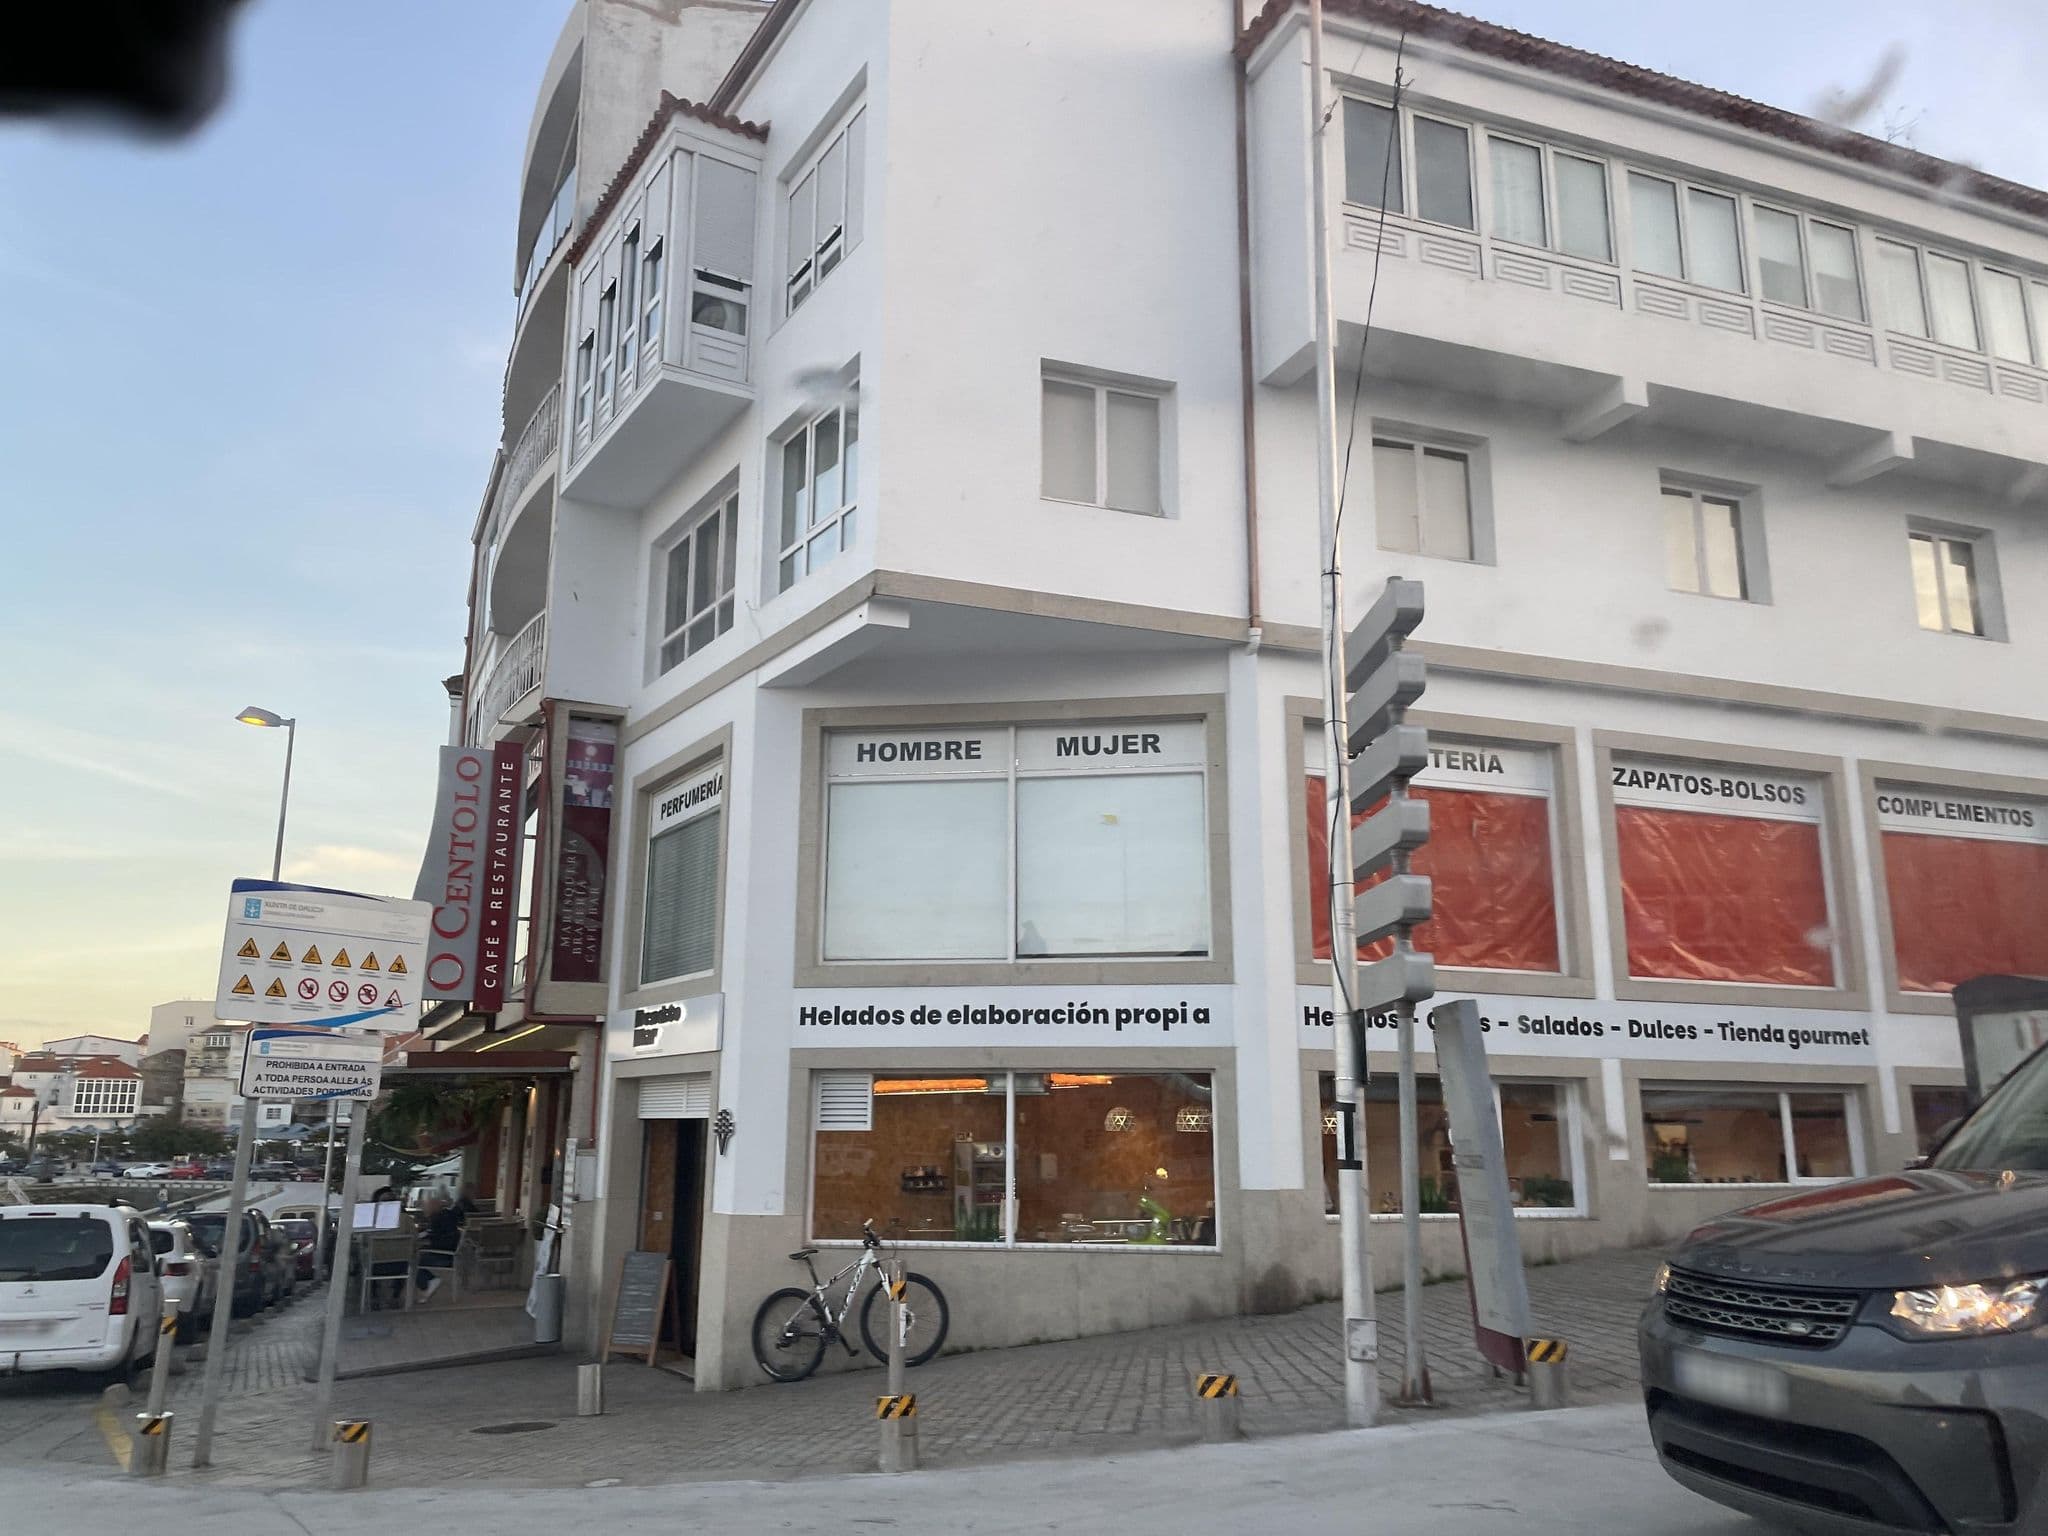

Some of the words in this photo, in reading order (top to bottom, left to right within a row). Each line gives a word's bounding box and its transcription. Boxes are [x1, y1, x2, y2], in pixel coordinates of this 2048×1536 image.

[857, 740, 982, 762] HOMBRE
[1056, 733, 1162, 757] MUJER
[1427, 746, 1505, 774] TERÍA
[660, 772, 723, 820] PERFUMERÍA
[1612, 767, 1807, 805] ZAPATOS-BOLSOS
[1877, 795, 2035, 828] COMPLEMENTOS
[431, 755, 483, 940] CENTOLO
[489, 761, 515, 910] RESTAURANTE
[427, 952, 466, 992] O
[484, 936, 501, 989] CAFÉ
[799, 1005, 905, 1026] Helados
[909, 1006, 943, 1025] de
[946, 1002, 1107, 1026] elaboración
[1517, 1014, 1604, 1037] Salados
[1628, 1019, 1698, 1040] Dulces
[1717, 1020, 1786, 1043] Tienda
[1788, 1028, 1870, 1050] gourmet
[255, 1074, 263, 1082] A
[265, 1074, 290, 1083] TODA
[292, 1075, 329, 1084] PERSOA
[331, 1076, 359, 1085] ALLEA
[265, 1060, 315, 1071] PROHIBIDA
[316, 1062, 323, 1071] A
[325, 1063, 367, 1072] ENTRADA
[252, 1085, 314, 1096] ACTIVIDADES
[315, 1087, 373, 1097] PORTUARIAS
